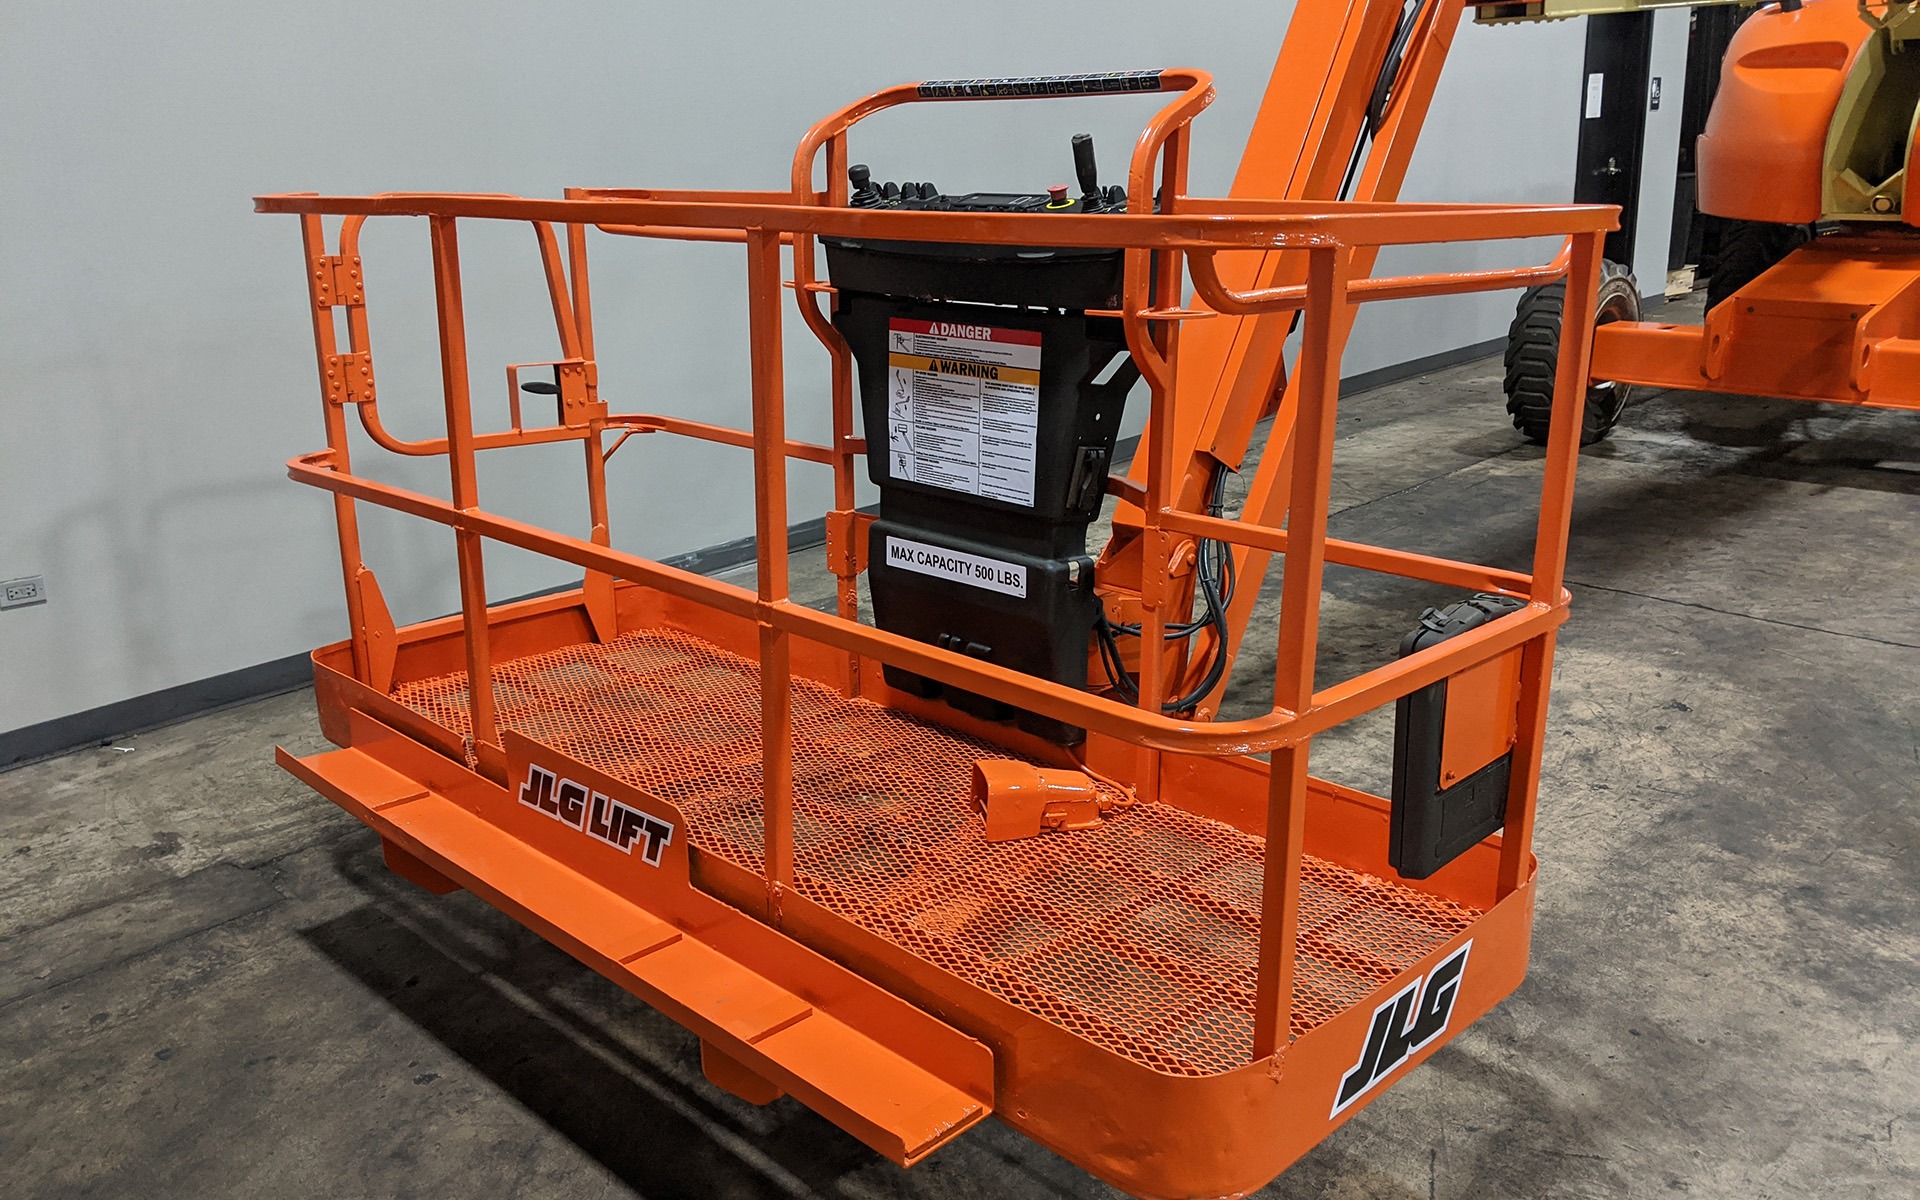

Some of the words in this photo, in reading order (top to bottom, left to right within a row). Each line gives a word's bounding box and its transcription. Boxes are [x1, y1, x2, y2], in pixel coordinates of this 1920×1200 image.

[940, 323, 992, 341] DANGER
[940, 360, 999, 380] WARNING
[891, 545, 915, 563] MAX
[917, 551, 973, 576] CAPACITY
[975, 564, 994, 582] 500
[997, 569, 1024, 589] LBS.
[520, 766, 587, 830] JLG
[588, 794, 672, 865] LIFT
[1334, 945, 1470, 1113] JLG
